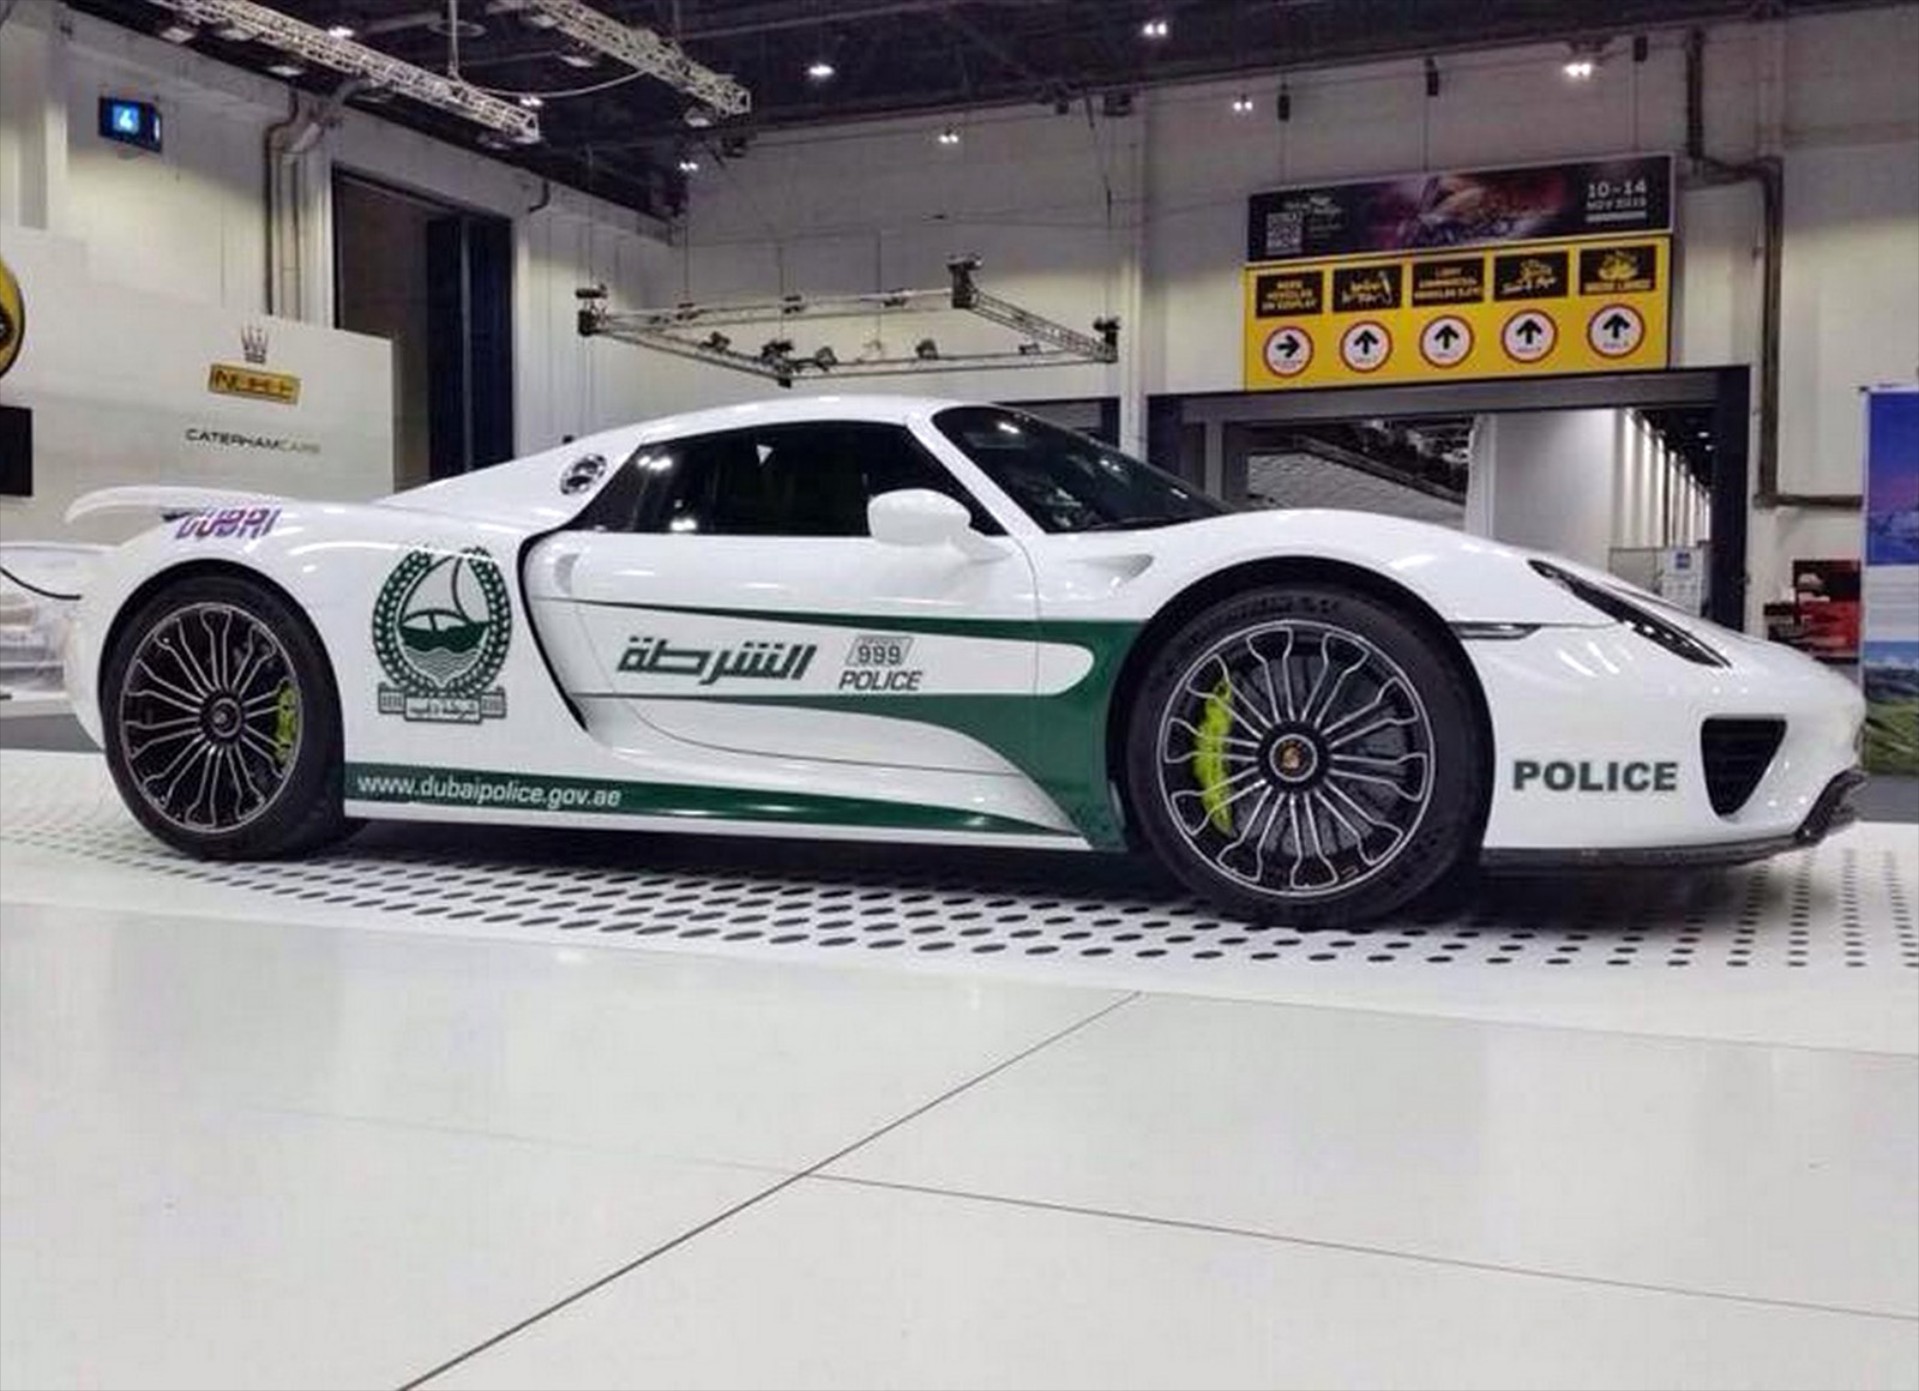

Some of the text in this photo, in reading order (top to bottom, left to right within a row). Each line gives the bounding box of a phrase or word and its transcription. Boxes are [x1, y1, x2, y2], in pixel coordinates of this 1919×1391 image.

[617, 636, 818, 686] الشرطة
[858, 644, 901, 665] 999
[838, 669, 924, 692] POLICE
[1513, 760, 1678, 792] POLICE
[357, 775, 622, 810] www.dubaipolice.gov.ae
